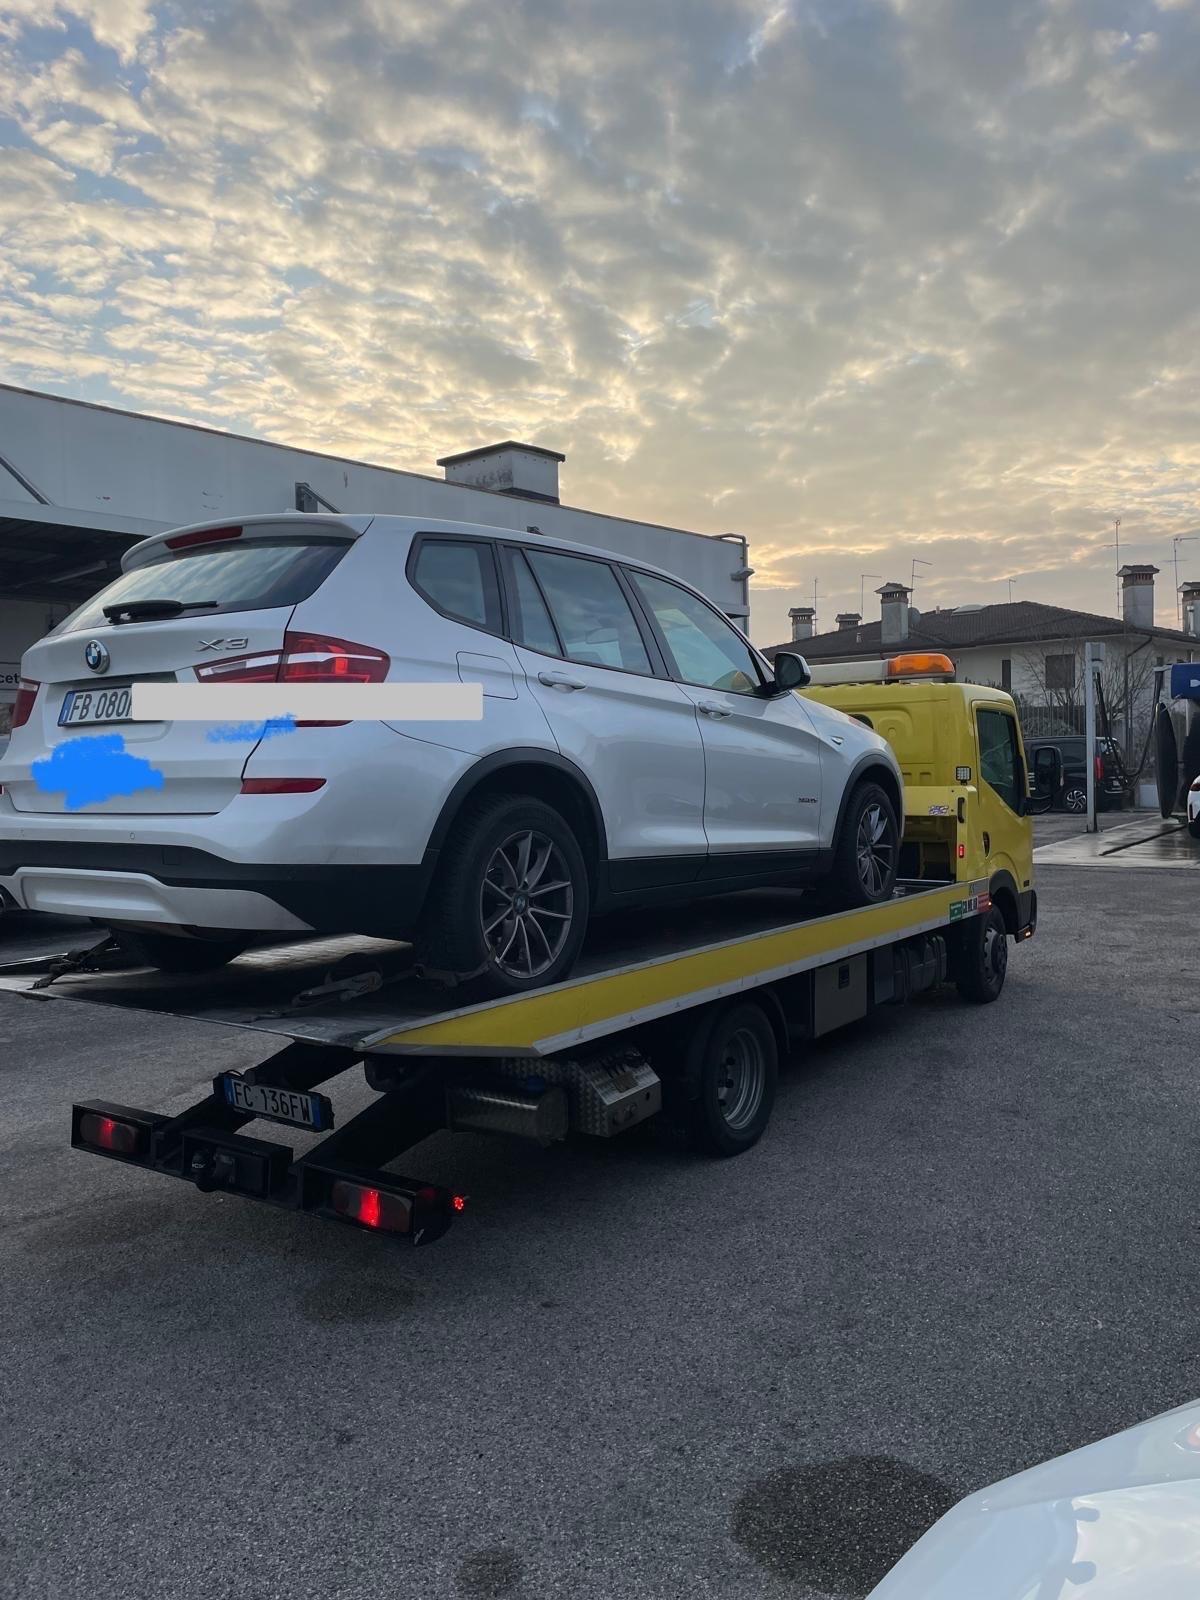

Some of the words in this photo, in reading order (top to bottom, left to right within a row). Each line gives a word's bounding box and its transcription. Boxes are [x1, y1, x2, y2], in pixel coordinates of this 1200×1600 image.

[195, 637, 249, 652] X3
[69, 693, 93, 721] FB
[233, 1081, 254, 1108] FC
[260, 1088, 311, 1123] 136FW
